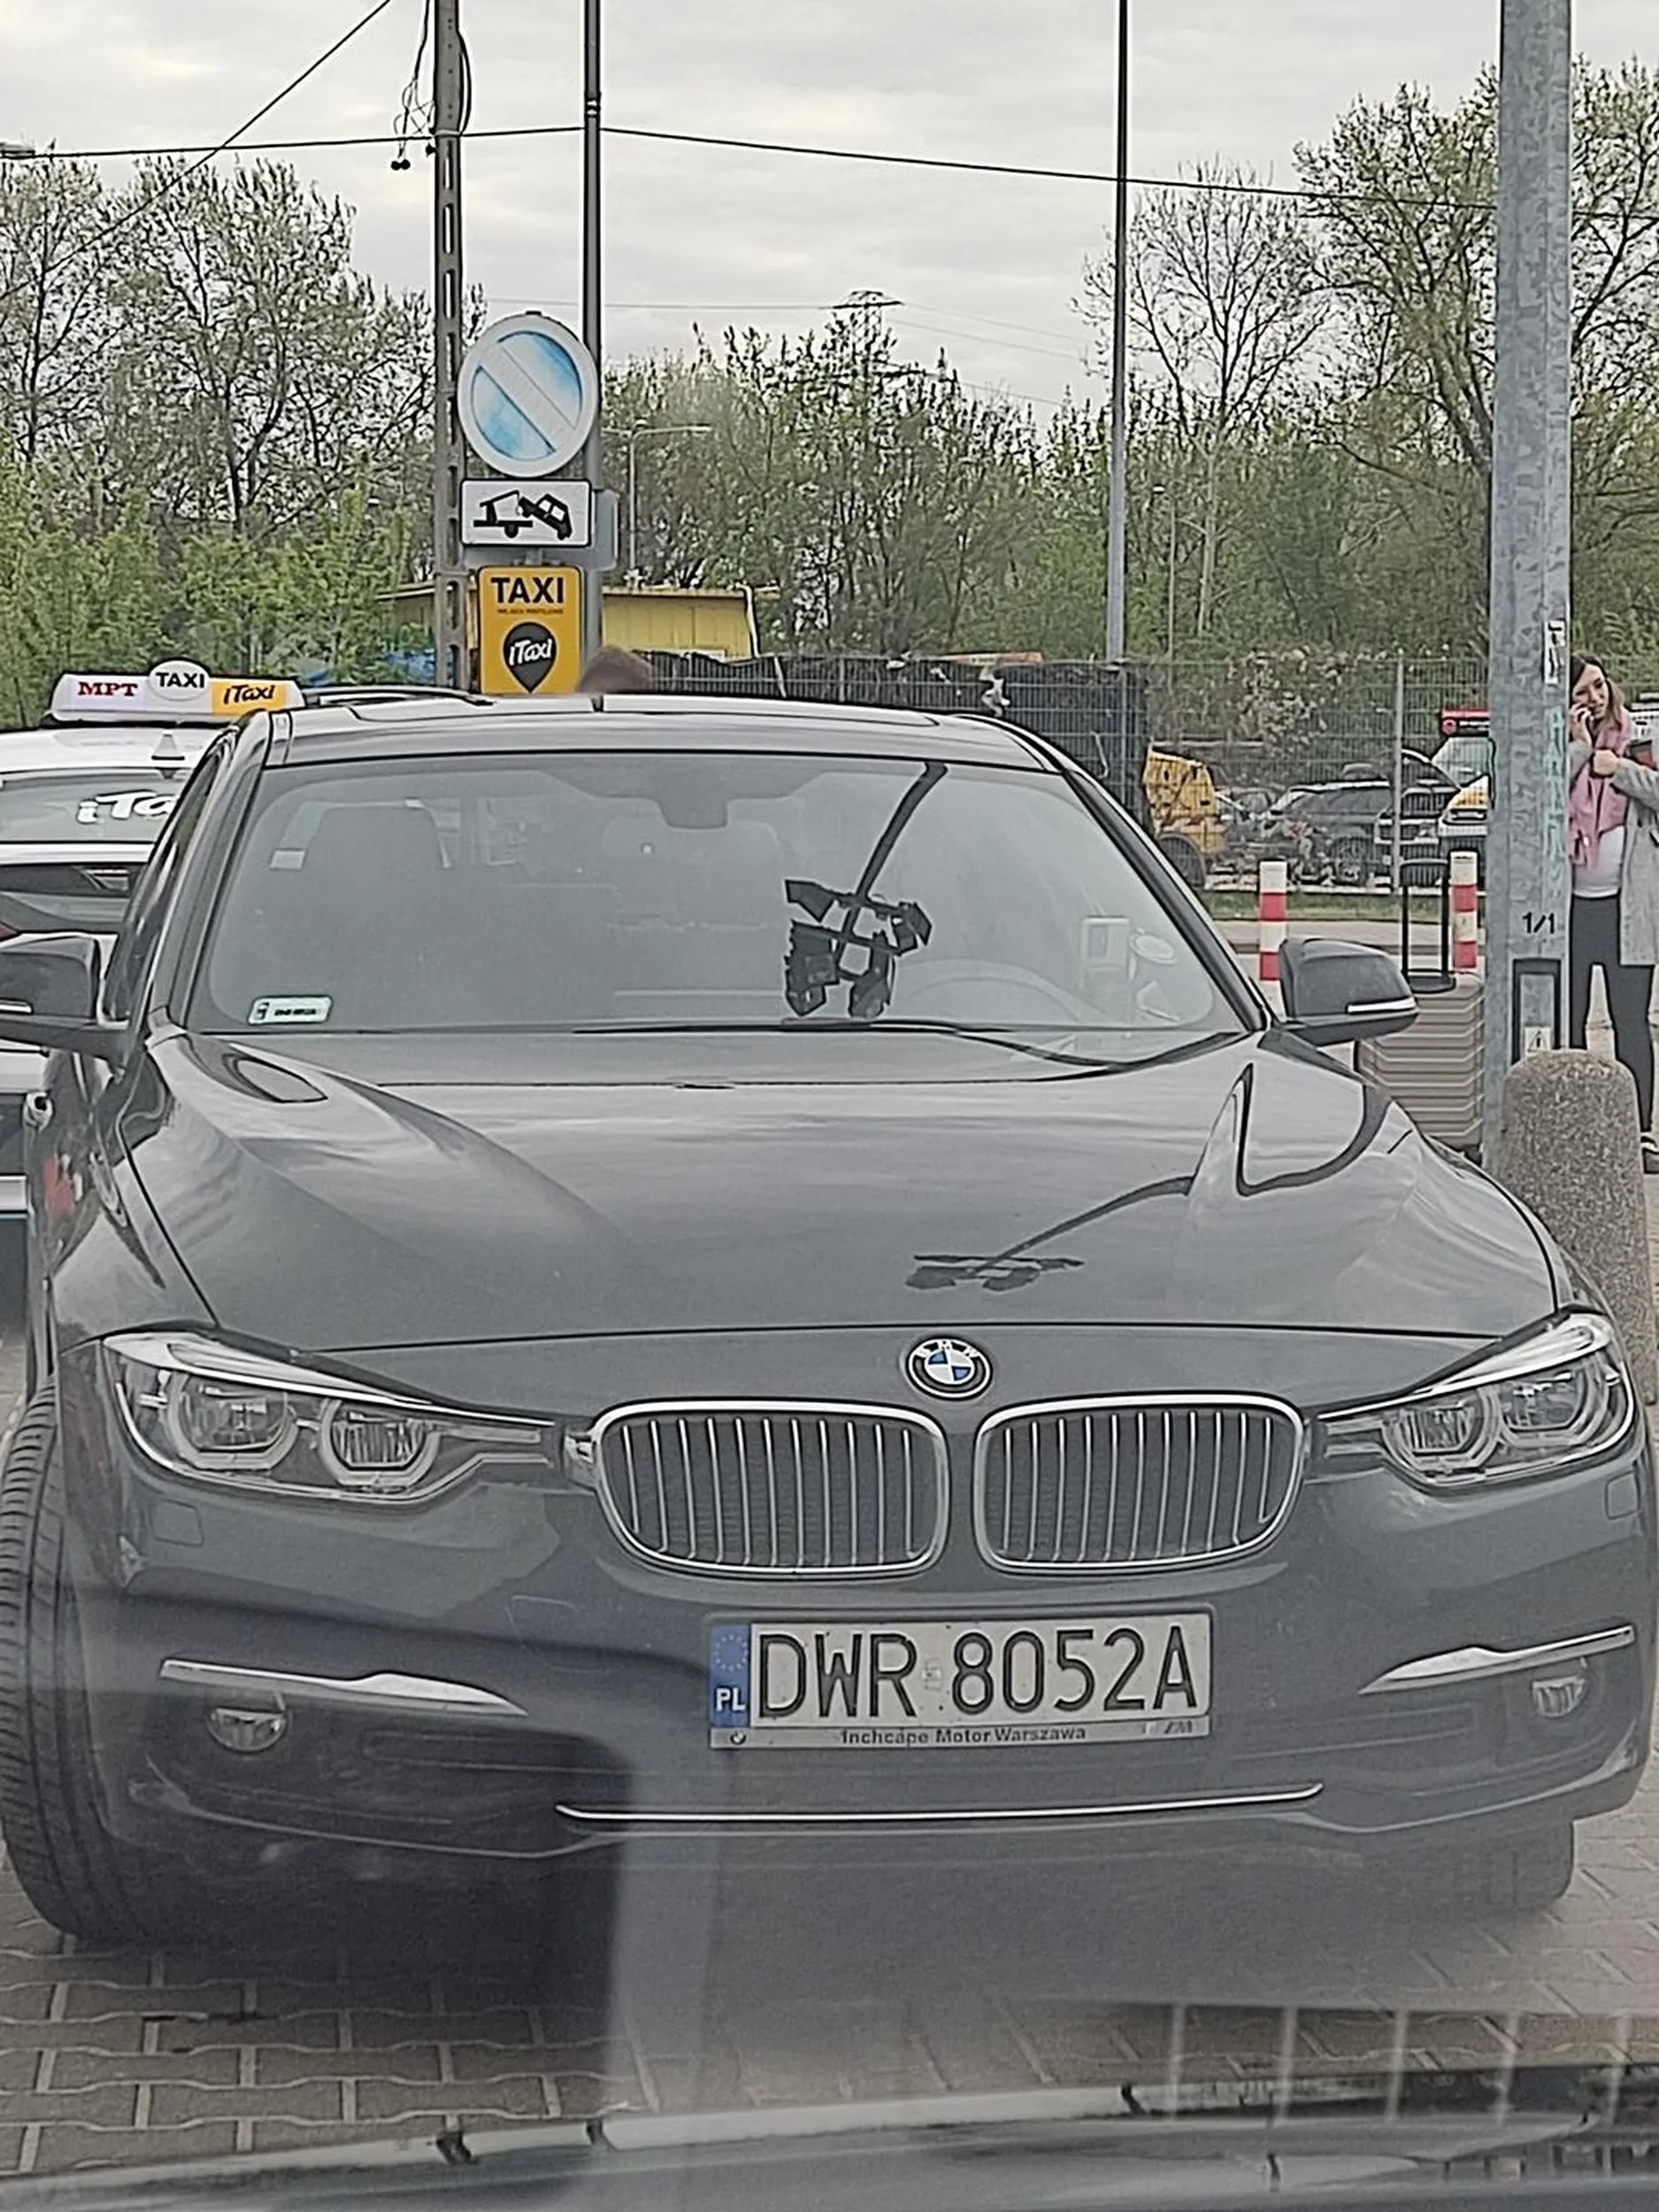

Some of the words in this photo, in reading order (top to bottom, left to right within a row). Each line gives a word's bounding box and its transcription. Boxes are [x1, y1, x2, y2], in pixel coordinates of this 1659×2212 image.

[490, 577, 565, 603] TAXI
[508, 638, 553, 666] iTaxi
[78, 680, 138, 697] MPT
[156, 672, 205, 689] TAXI
[223, 684, 276, 704] iTaxi
[1522, 911, 1555, 934] 1/1
[758, 1632, 918, 1718] DWR
[950, 1625, 1197, 1715] 8052A
[715, 1687, 747, 1712] PL
[842, 1729, 928, 1748] Inchcape
[935, 1730, 992, 1744] Motor
[995, 1726, 1087, 1743] Warszawa
